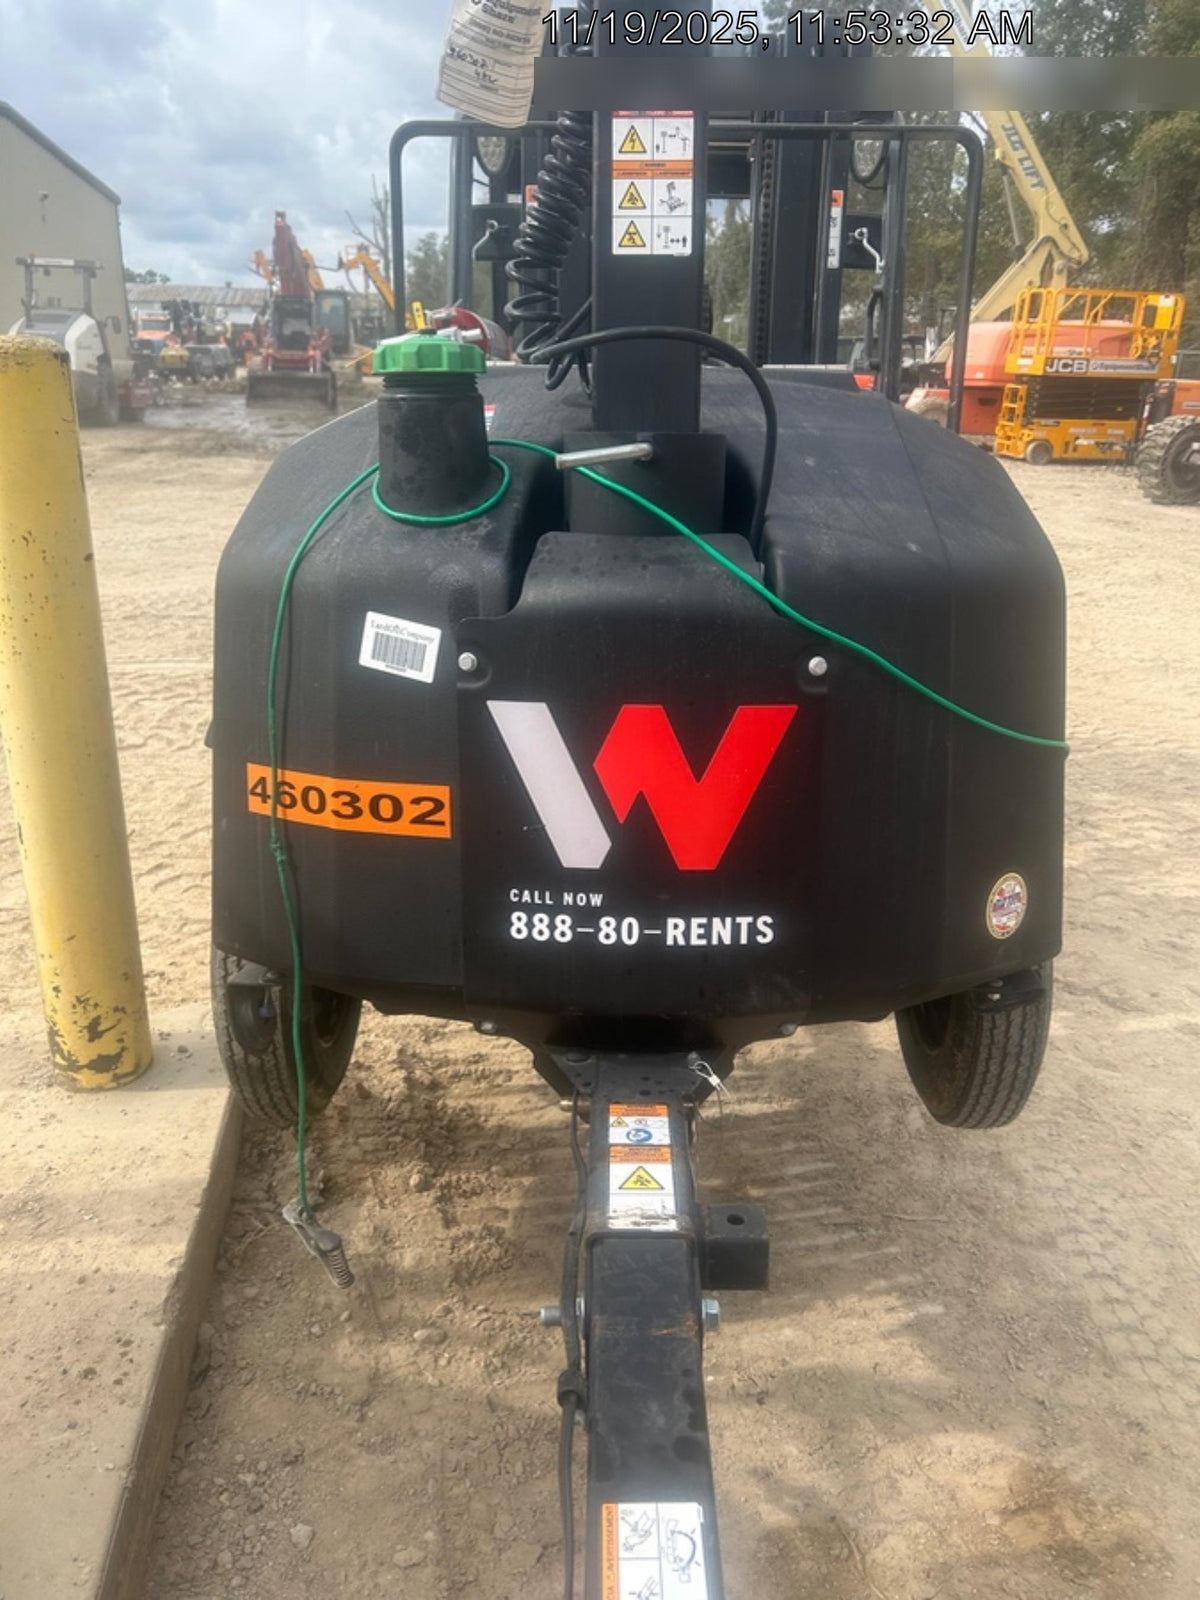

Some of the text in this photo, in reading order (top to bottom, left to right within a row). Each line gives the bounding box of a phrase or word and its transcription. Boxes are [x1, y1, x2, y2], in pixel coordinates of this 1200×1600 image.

[1001, 124, 1047, 190] JLG LIFT
[1045, 359, 1088, 374] JCB
[249, 775, 446, 826] 460302
[509, 888, 604, 908] CALL NOW
[509, 911, 775, 946] 888-80-RENTS
